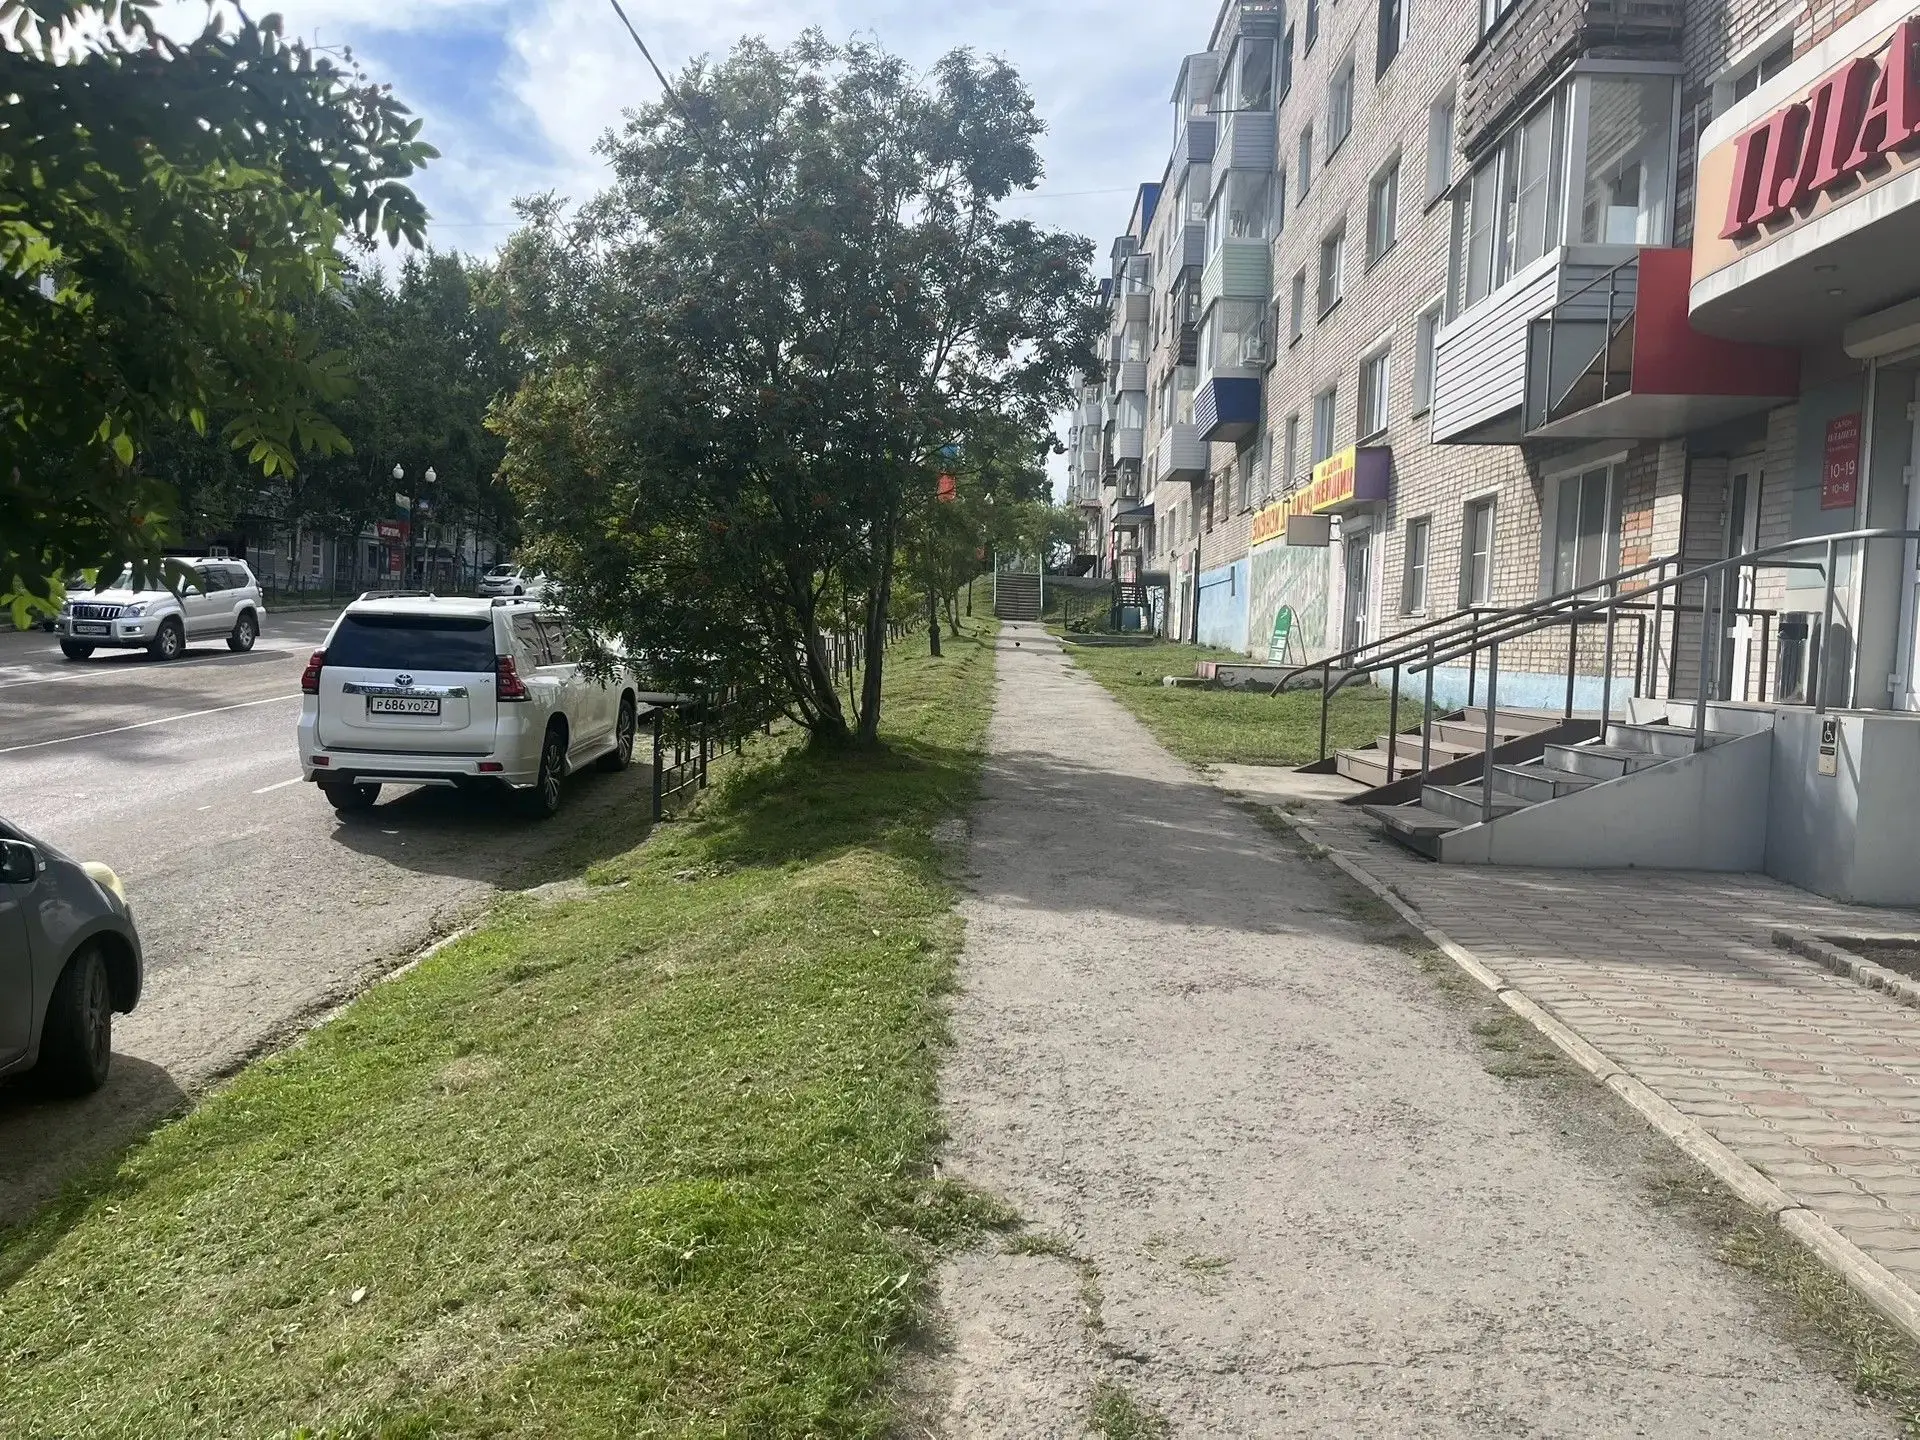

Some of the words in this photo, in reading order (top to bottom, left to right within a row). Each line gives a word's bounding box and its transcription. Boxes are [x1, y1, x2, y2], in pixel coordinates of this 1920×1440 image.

[1718, 16, 1920, 239] ПЛА
[1830, 460, 1855, 478] 10-19
[1313, 467, 1353, 506] ЖЕНЩИН
[423, 700, 435, 709] 27
